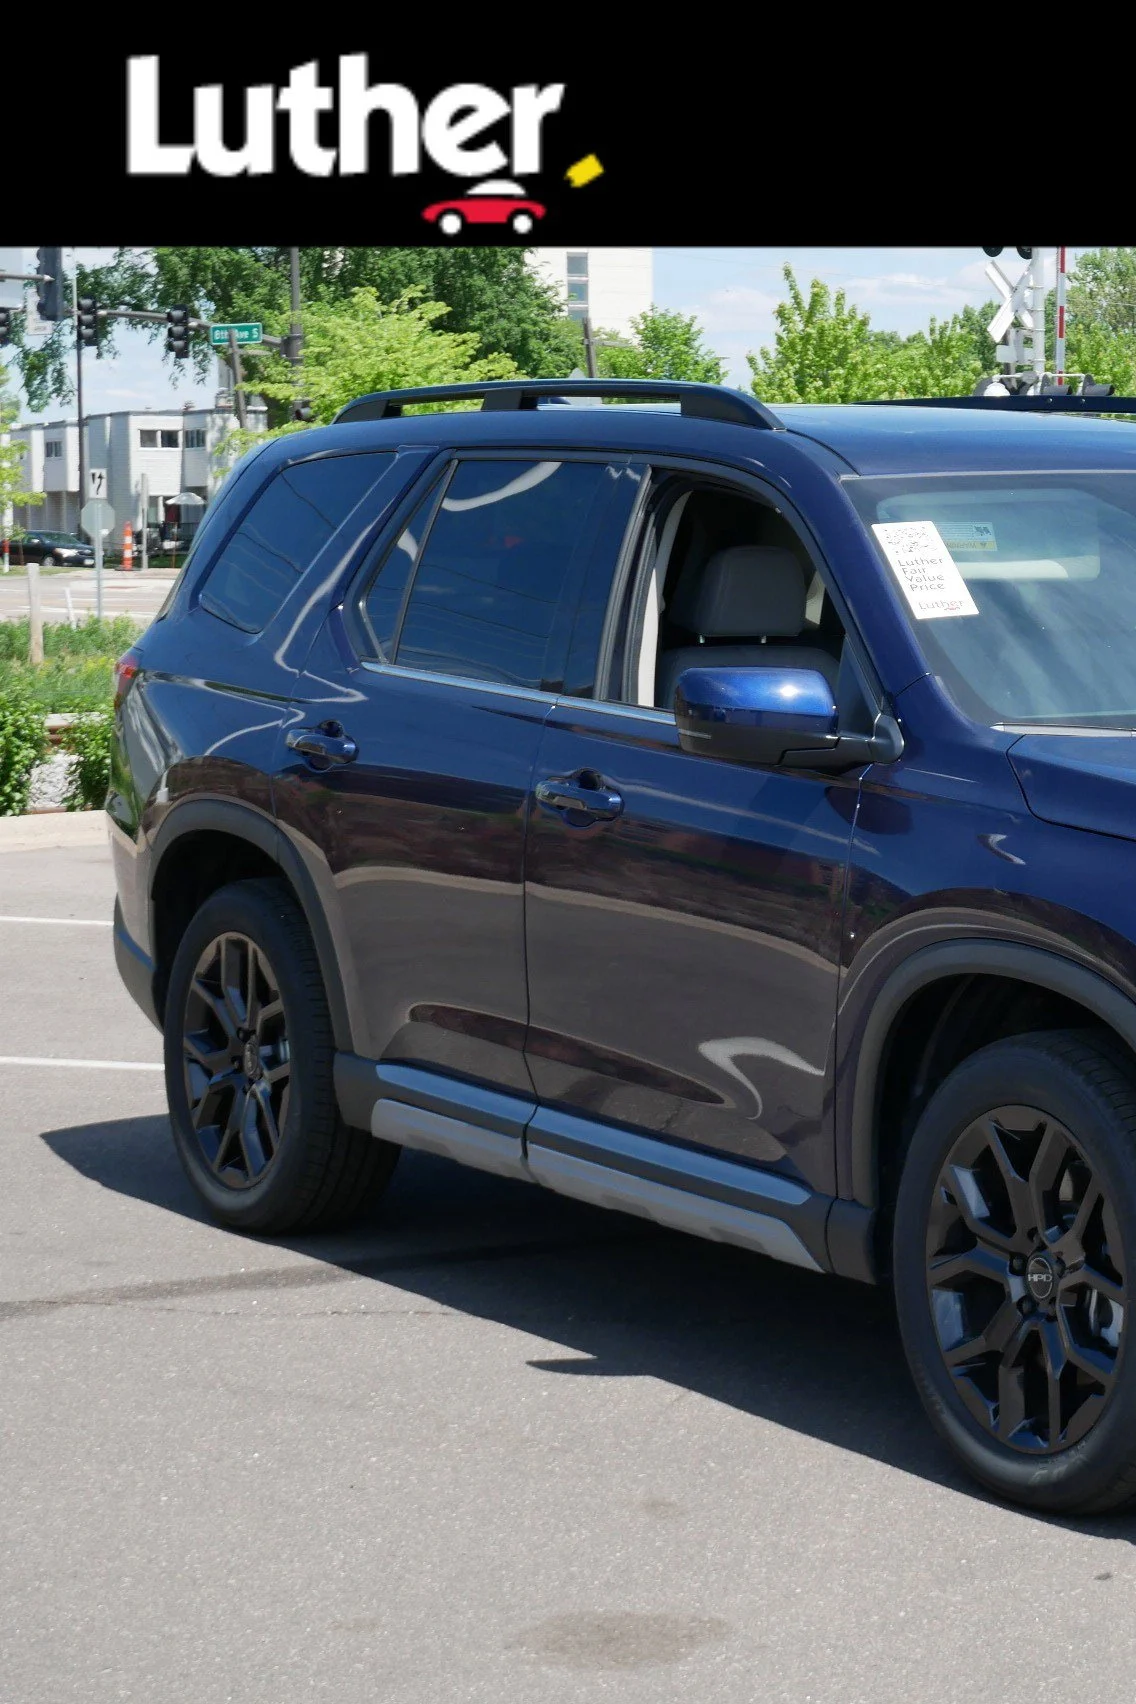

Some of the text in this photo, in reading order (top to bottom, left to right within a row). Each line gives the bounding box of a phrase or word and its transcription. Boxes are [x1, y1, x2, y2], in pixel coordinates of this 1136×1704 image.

[898, 558, 943, 567] Luther
[902, 567, 926, 575] Fair
[905, 575, 945, 583] Value
[910, 583, 945, 592] Price
[918, 600, 964, 610] Luther
[1028, 1273, 1053, 1282] HPD
